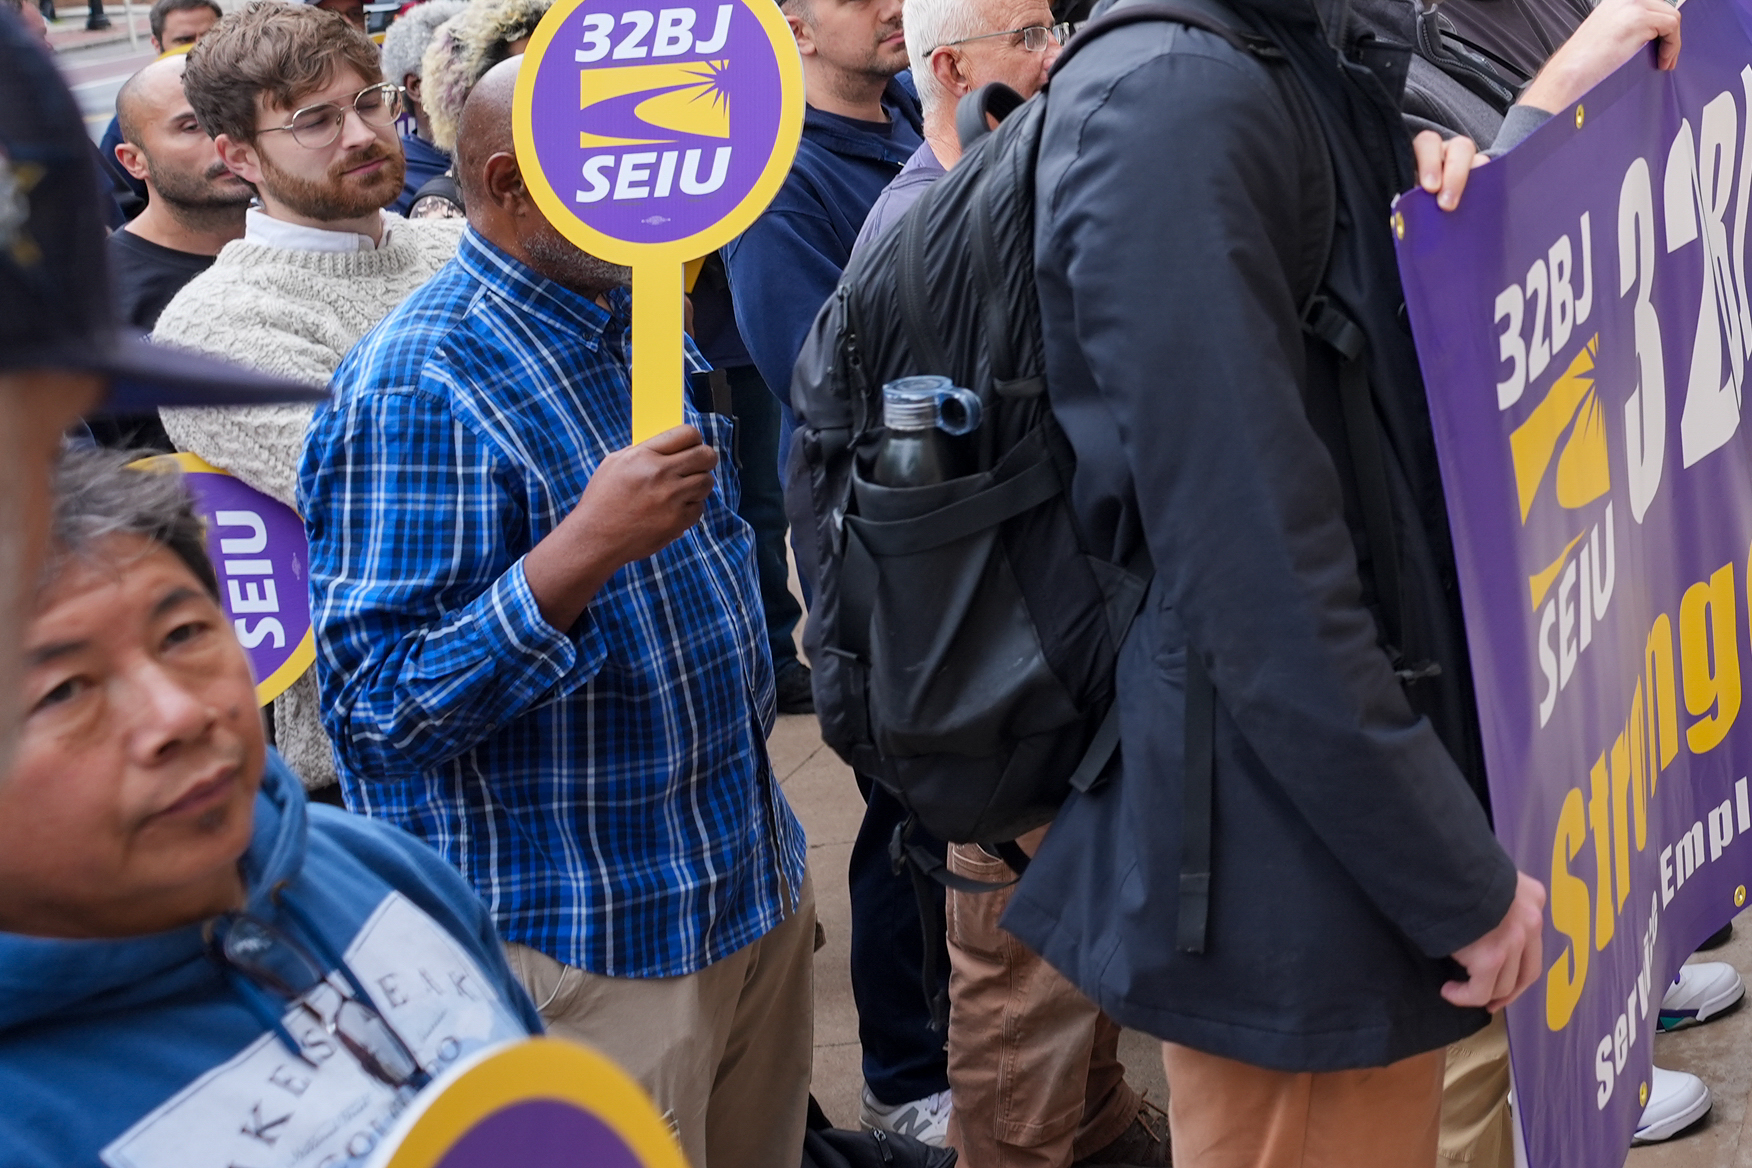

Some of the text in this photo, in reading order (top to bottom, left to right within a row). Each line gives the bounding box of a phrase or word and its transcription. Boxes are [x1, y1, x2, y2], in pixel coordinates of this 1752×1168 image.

[574, 3, 734, 63] 32BJ
[574, 146, 733, 204] SEIU
[1494, 210, 1593, 411] 32BJ
[215, 510, 286, 650] SEIU
[1538, 499, 1616, 730] SEIU
